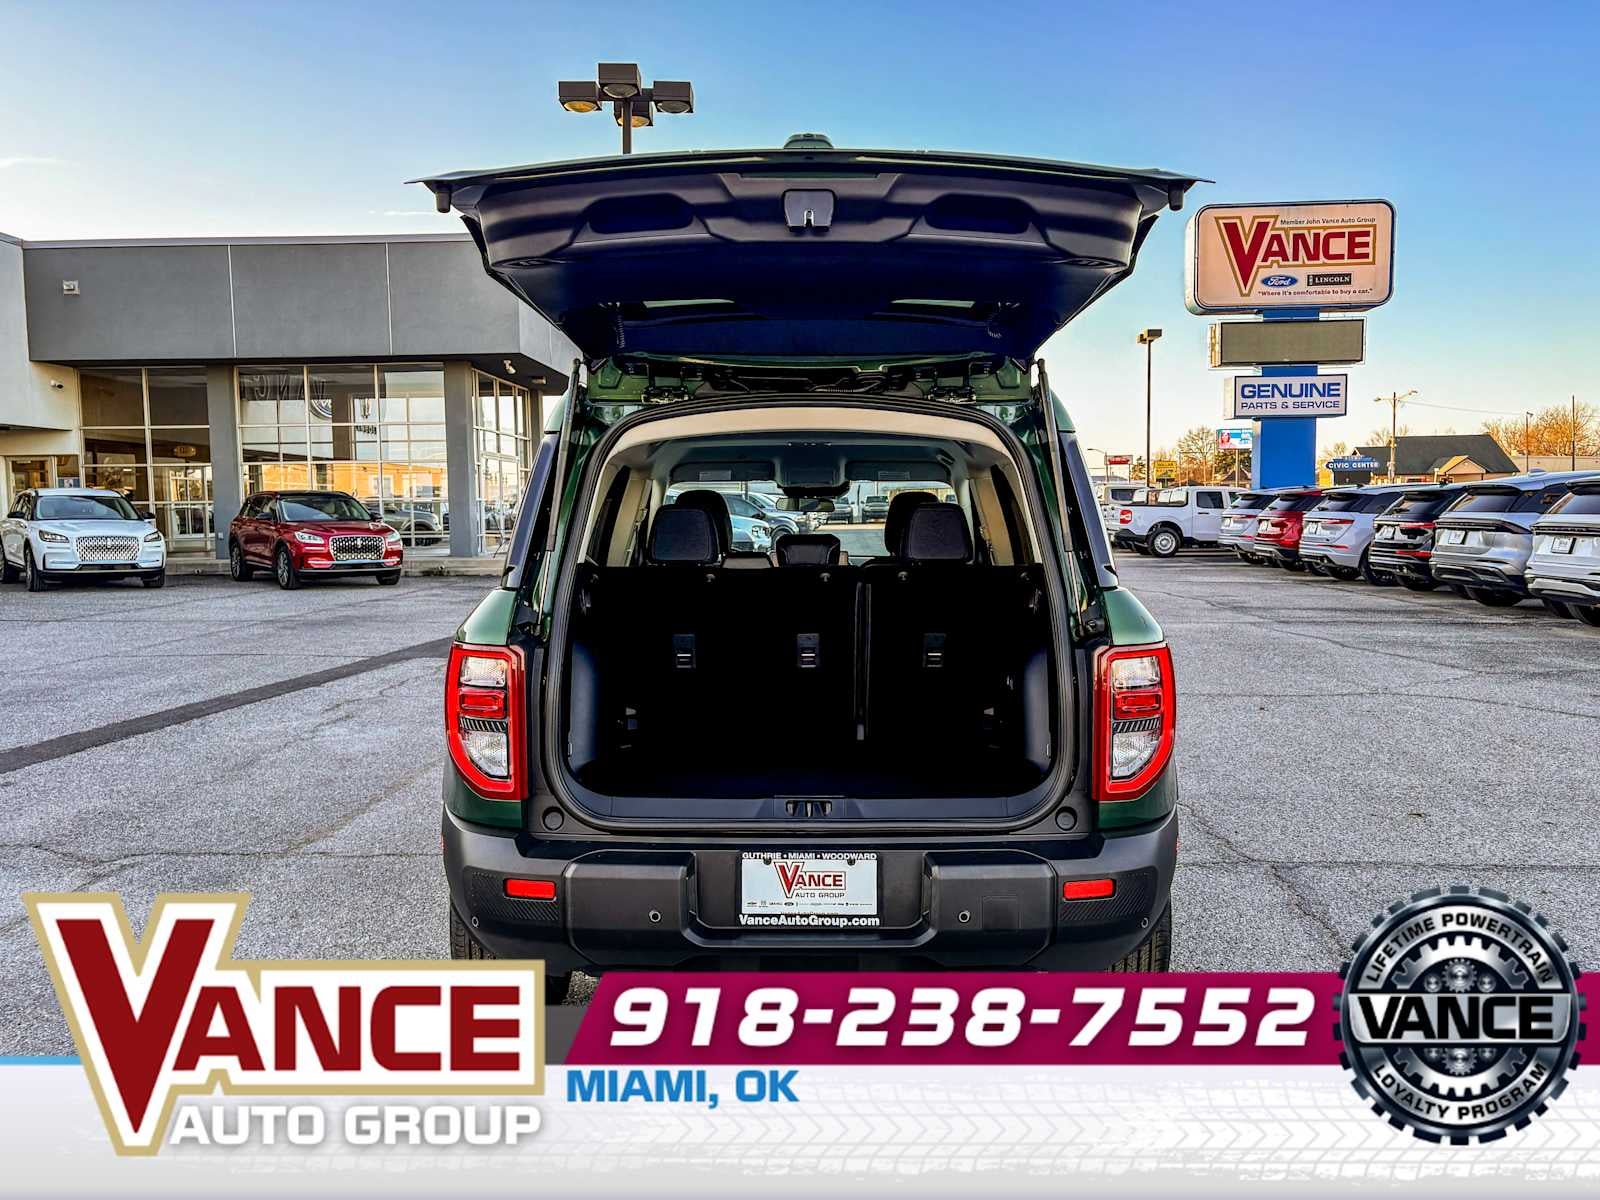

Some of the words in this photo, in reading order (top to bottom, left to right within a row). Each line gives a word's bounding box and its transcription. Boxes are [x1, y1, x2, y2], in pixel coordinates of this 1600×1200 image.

[1280, 217, 1305, 225] Member
[1306, 217, 1321, 225] John
[1322, 216, 1340, 224] Vance
[1356, 215, 1376, 223] Group
[1223, 220, 1371, 290] VANCE
[1267, 276, 1292, 287] Ford
[1315, 275, 1350, 284] LINCOLN
[1340, 288, 1351, 296] buy
[1240, 383, 1341, 398] GENUINE
[1241, 401, 1277, 410] PARTS
[1281, 401, 1289, 409] &
[1293, 400, 1340, 409] SERVICE
[742, 852, 782, 860] GUTHRIE
[788, 852, 816, 860] MIAMI
[822, 852, 877, 860] WOODWARD
[777, 864, 843, 895] VANCE
[738, 914, 880, 928] VanceAutoGroup.com
